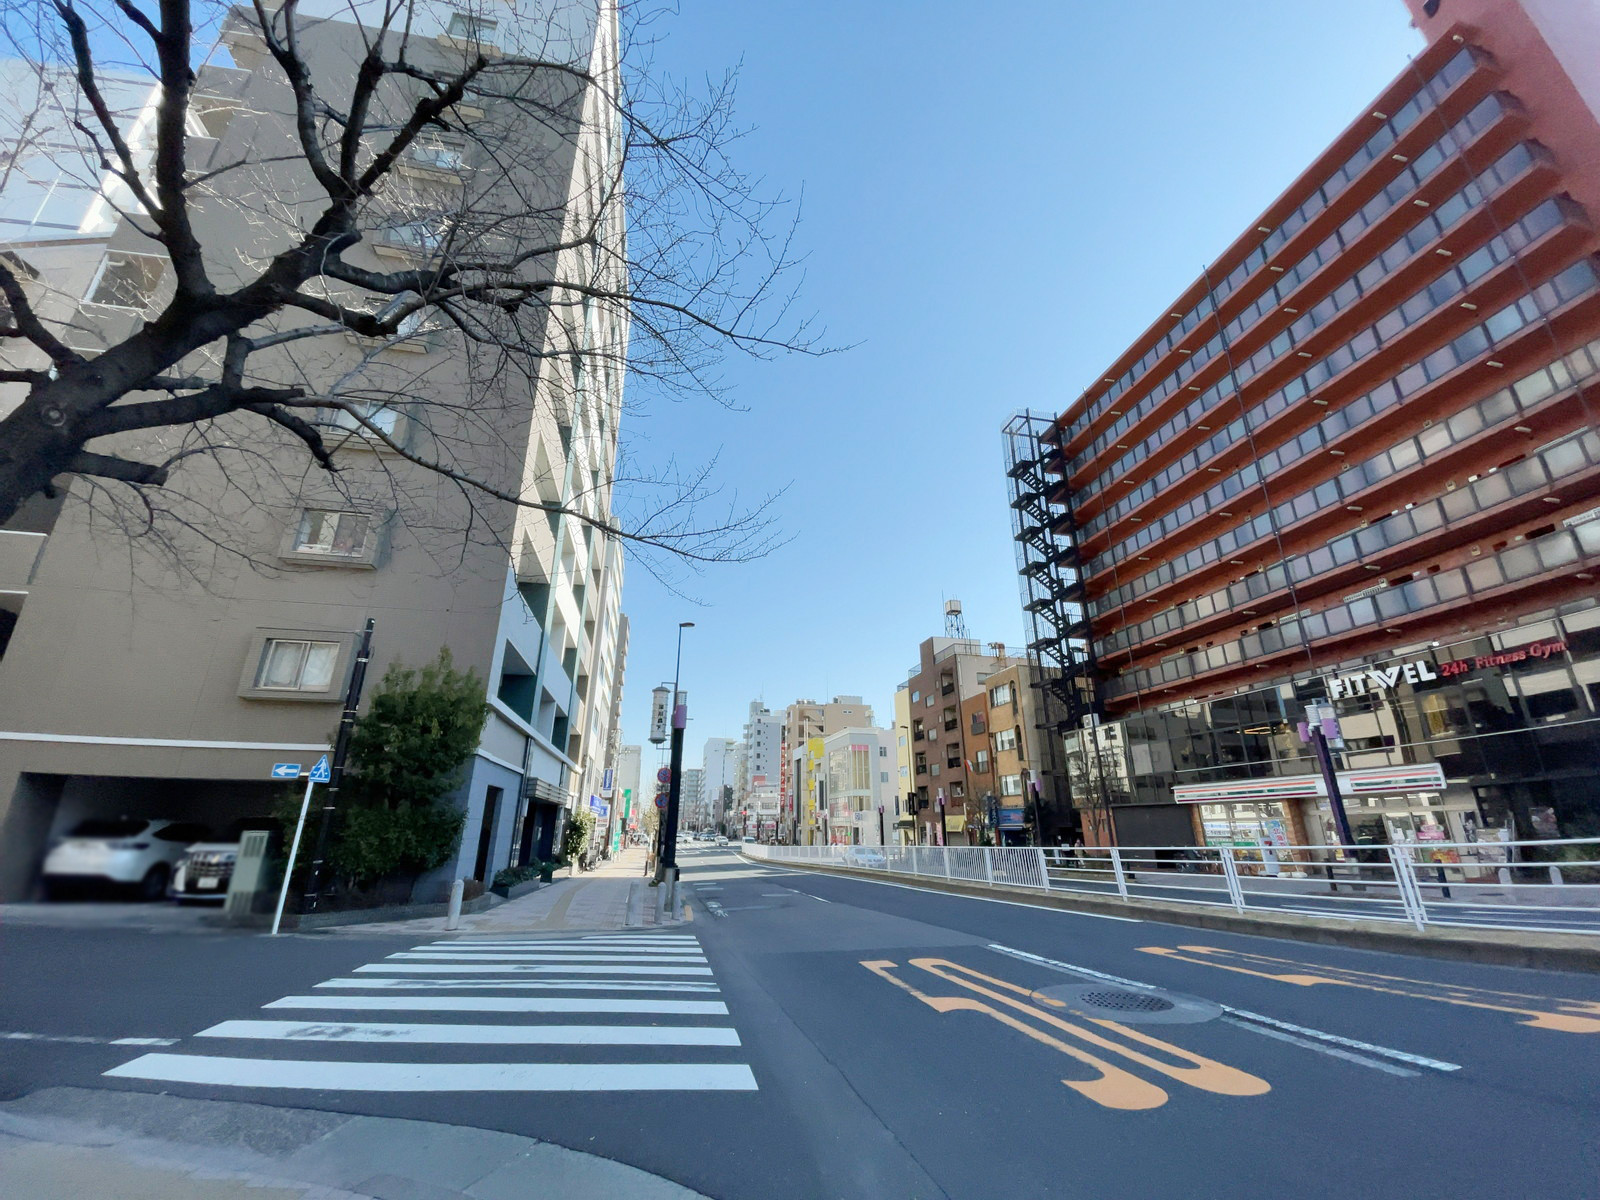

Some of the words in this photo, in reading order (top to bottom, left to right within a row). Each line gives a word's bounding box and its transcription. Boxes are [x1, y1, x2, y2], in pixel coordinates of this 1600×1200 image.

[1441, 663, 1469, 677] 24h
[1475, 651, 1526, 668] Fitness
[1530, 641, 1566, 658] Gym
[1329, 660, 1437, 699] FITWEL
